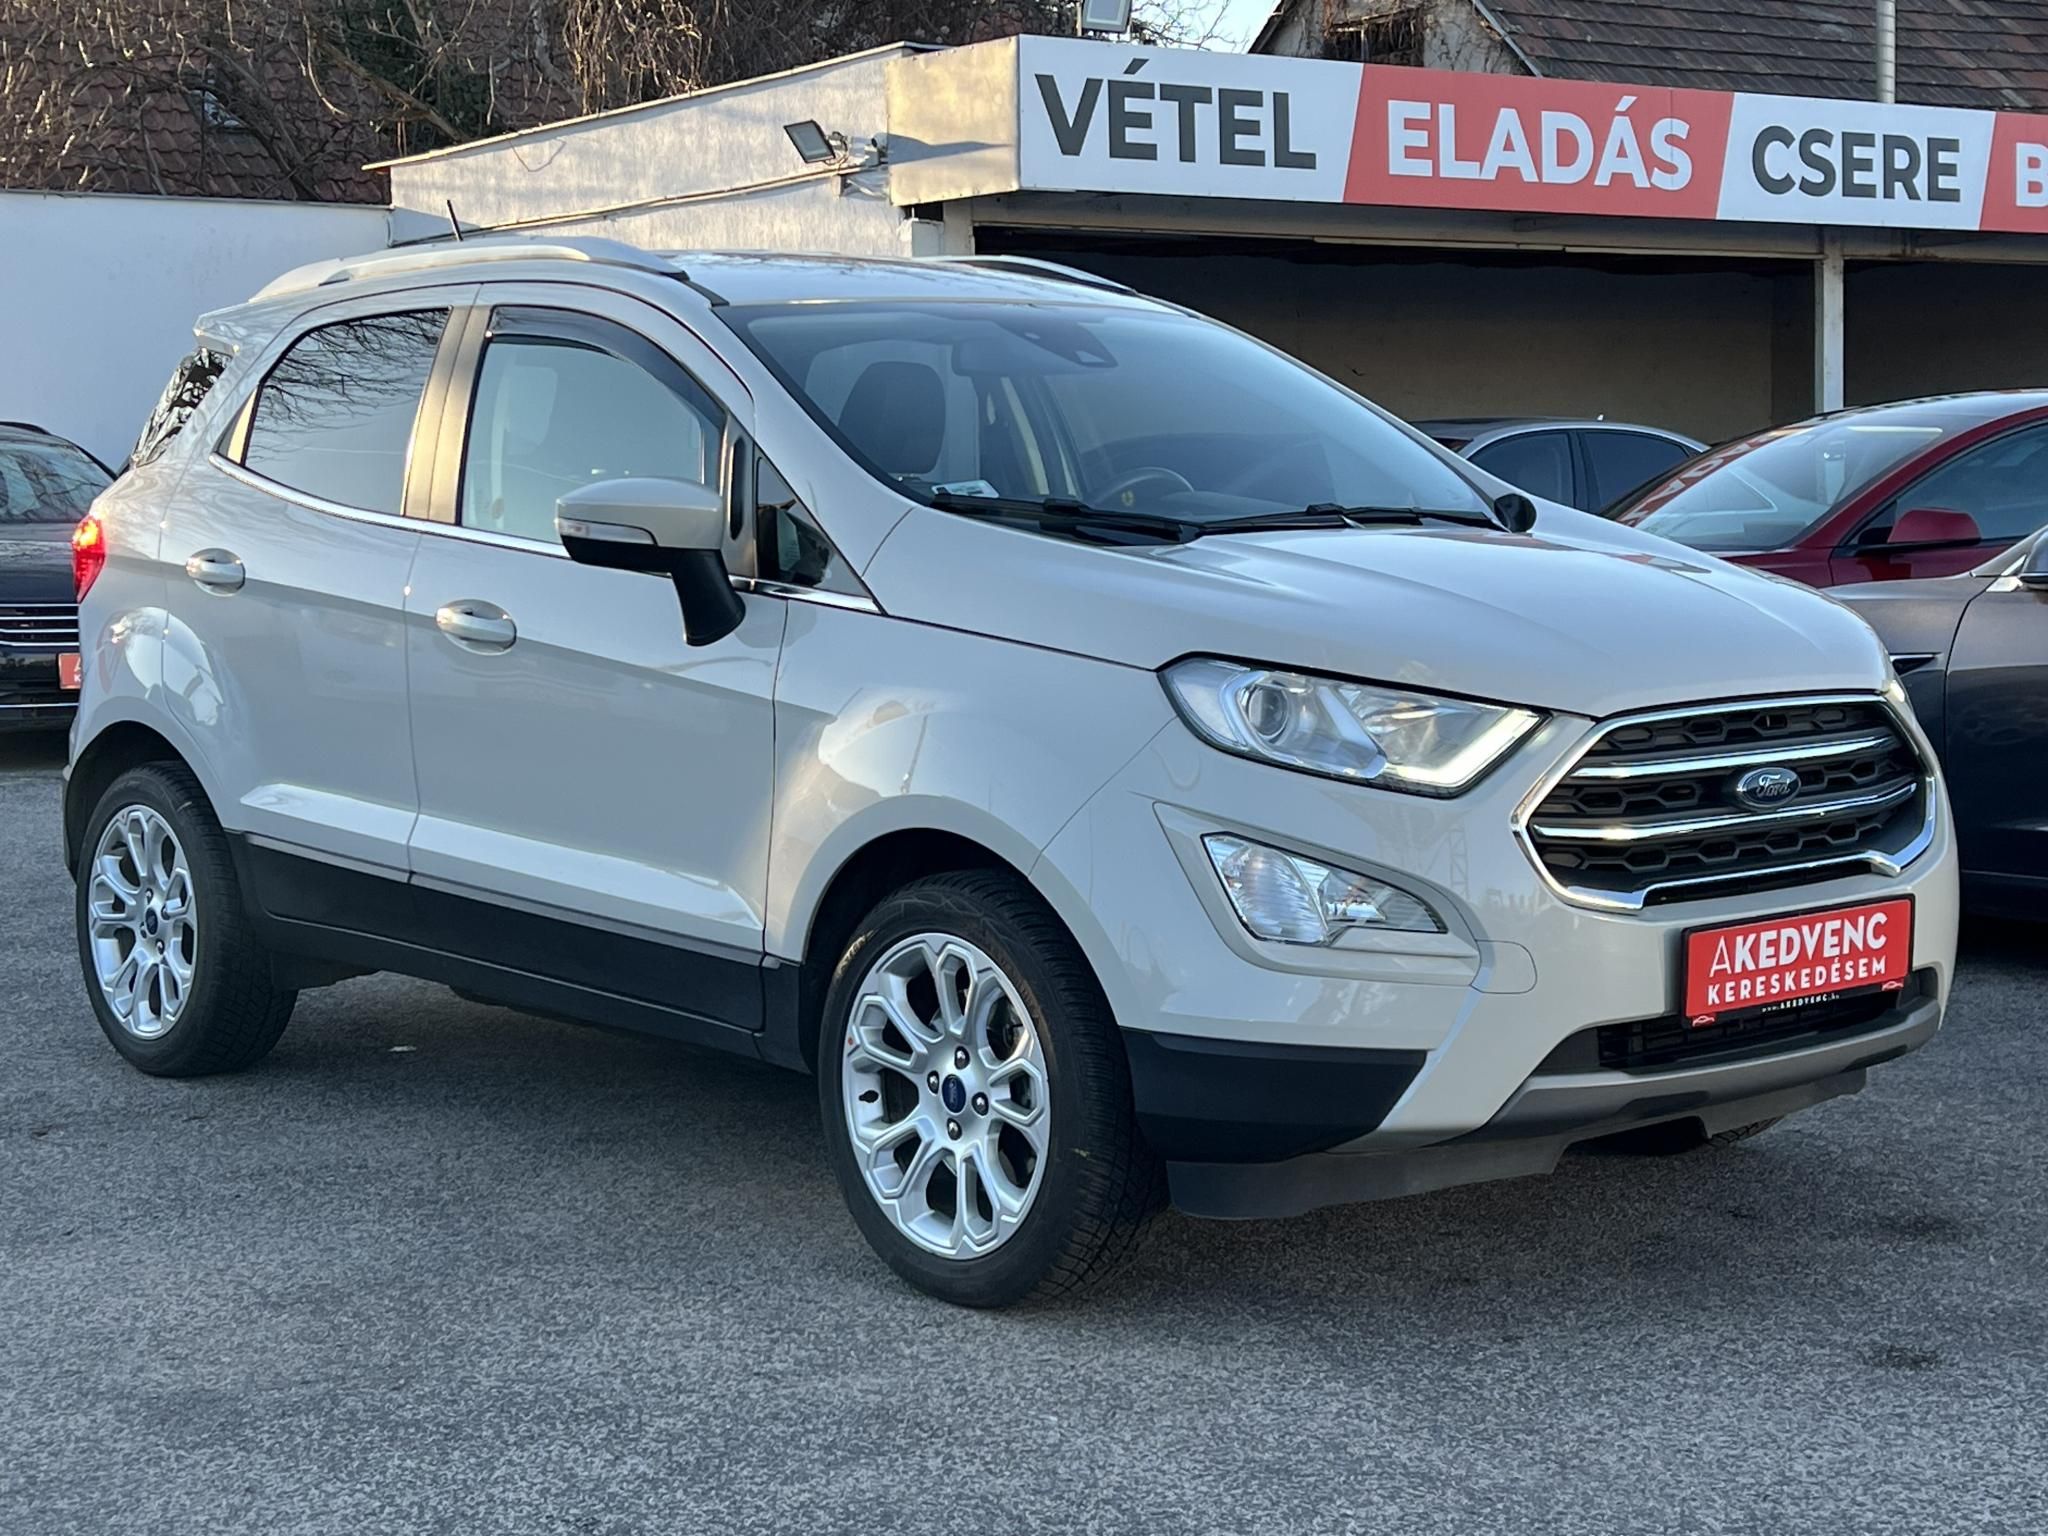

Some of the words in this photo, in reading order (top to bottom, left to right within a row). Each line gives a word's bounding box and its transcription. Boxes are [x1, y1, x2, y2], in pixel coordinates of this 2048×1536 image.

[1034, 57, 1317, 170] VÉTEL
[1387, 95, 1693, 191] ELADÁS
[1752, 125, 1961, 202] CSERE
[1756, 774, 1790, 797] Ford
[1707, 955, 1886, 1006] KERESKEDÉSEM
